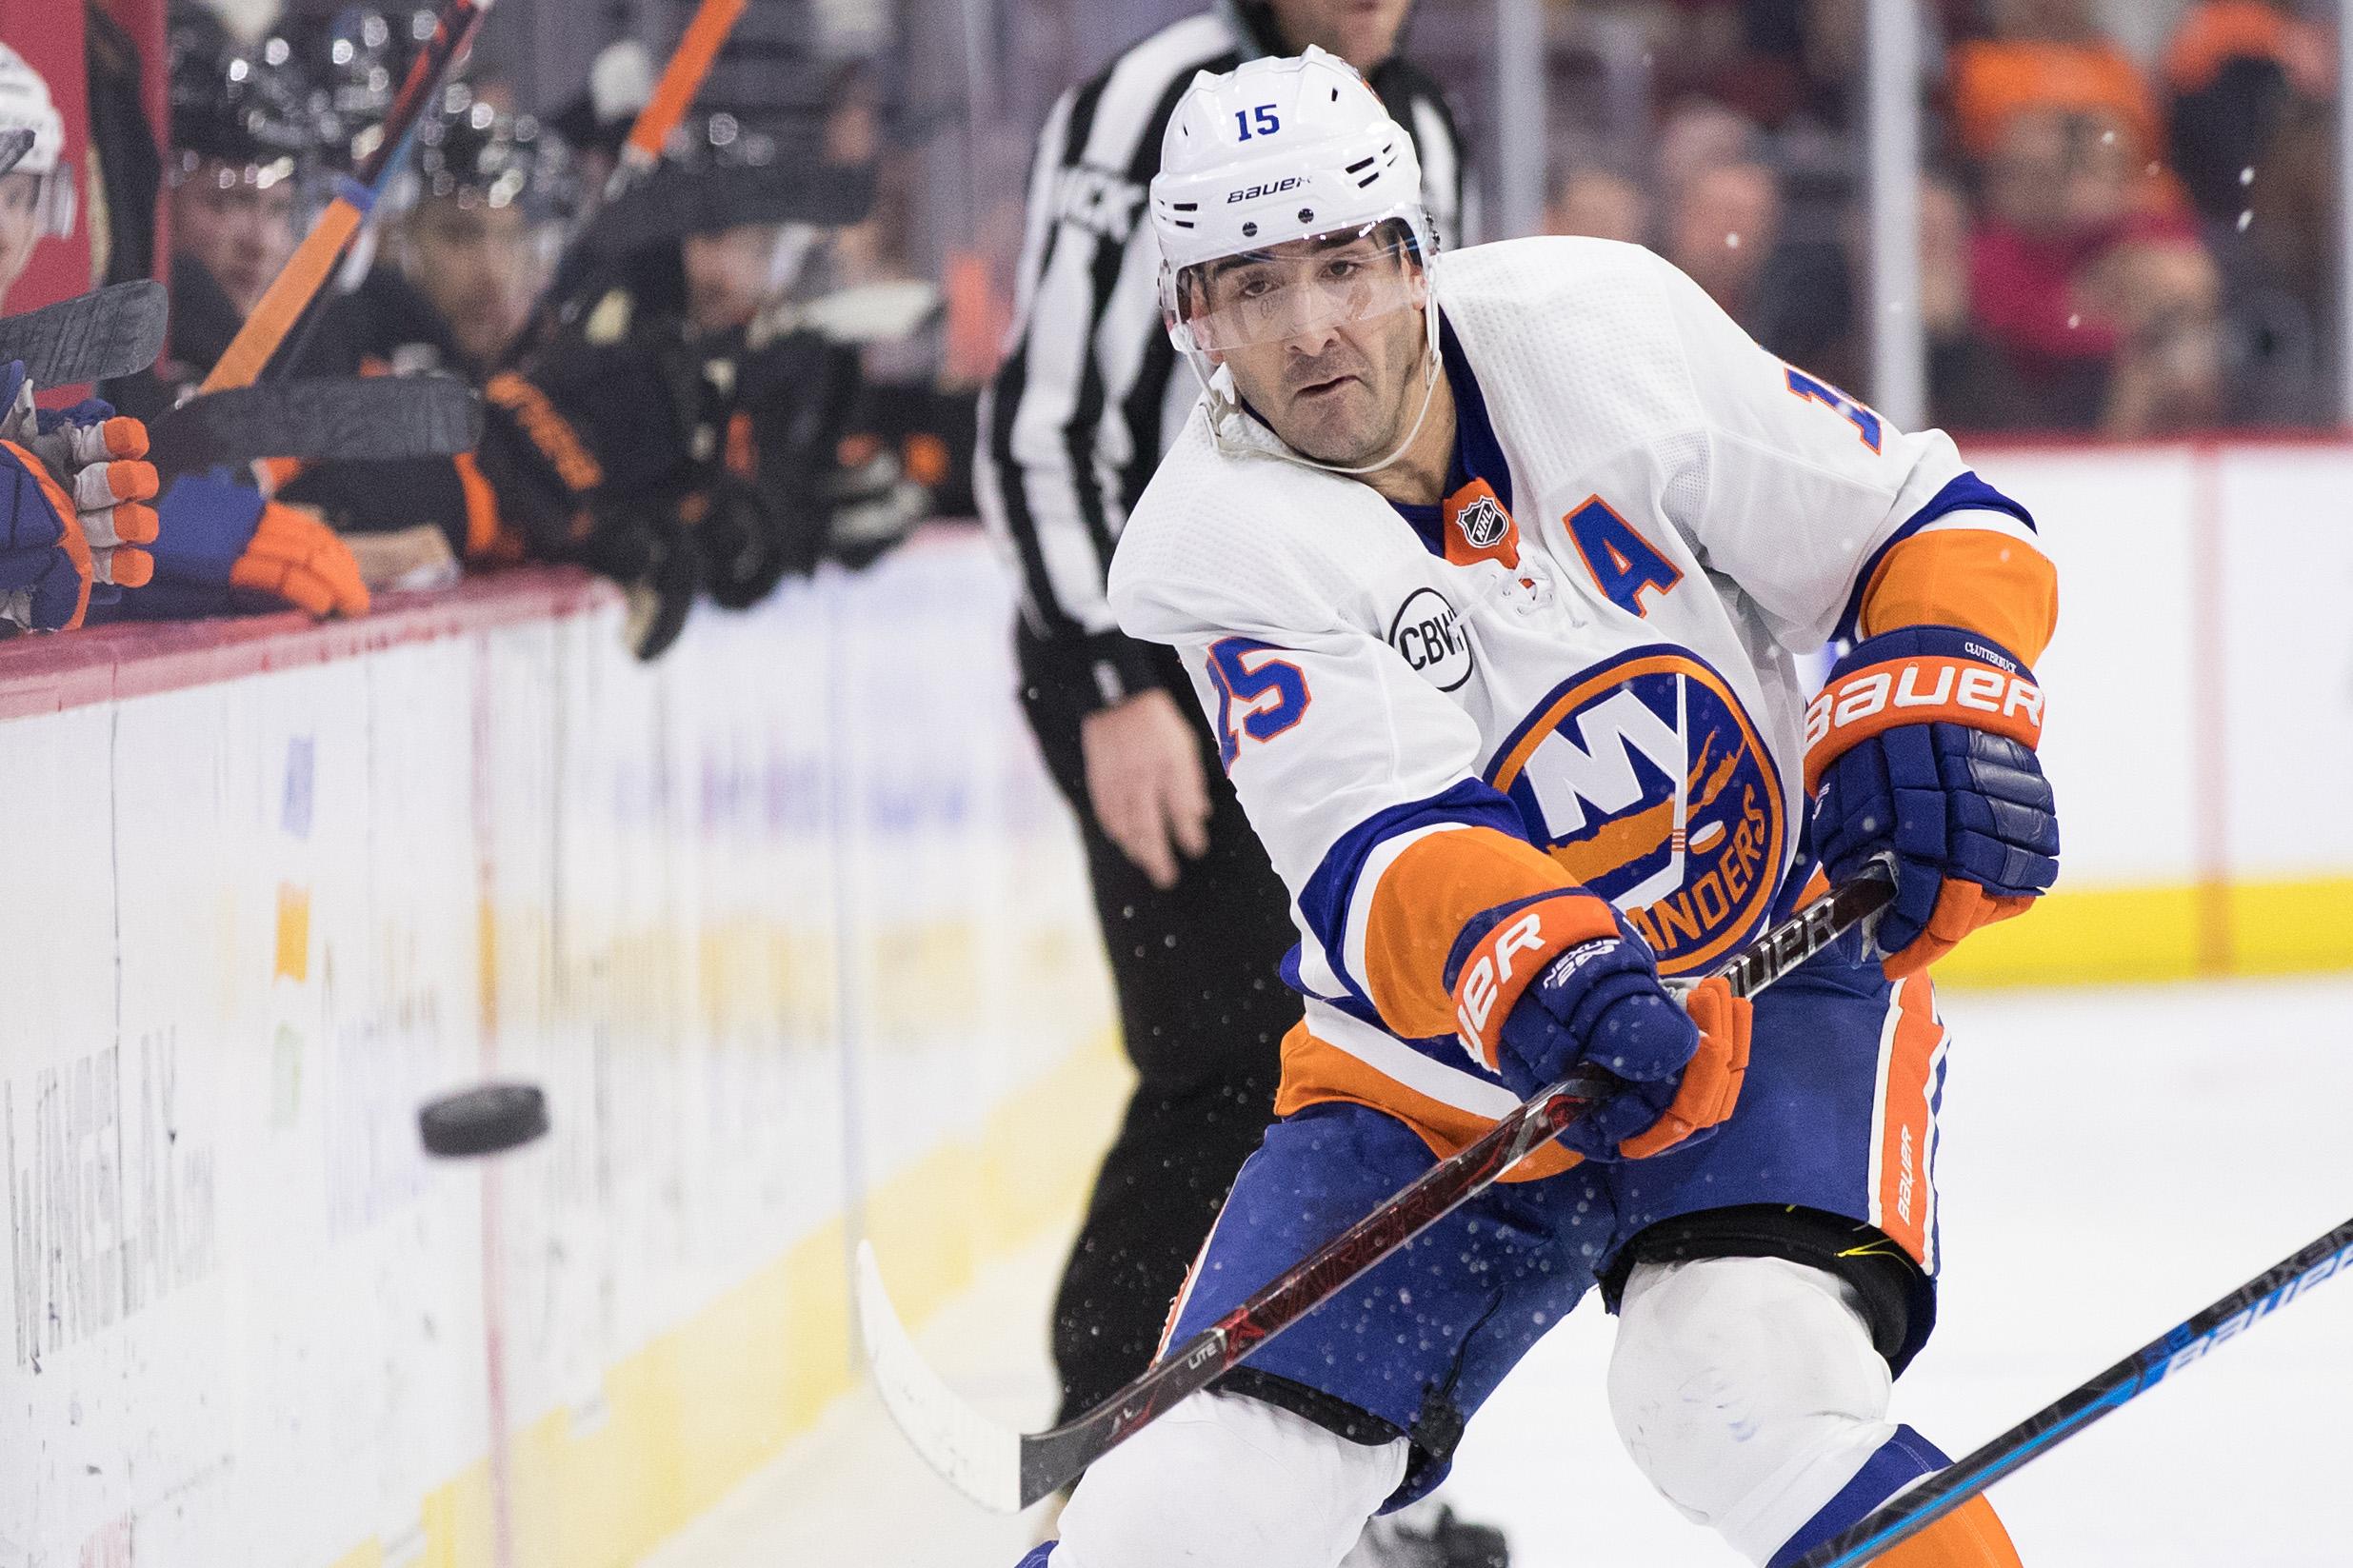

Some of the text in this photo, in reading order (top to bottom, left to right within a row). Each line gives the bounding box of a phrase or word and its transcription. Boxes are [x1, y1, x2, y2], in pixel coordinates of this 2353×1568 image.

[1235, 104, 1280, 142] 15
[1475, 507, 1493, 541] NHL
[1563, 493, 1685, 620] A
[1399, 609, 1466, 671] CBW
[1964, 642, 2017, 674] CLUTTERBUCK
[1525, 673, 1687, 862] NY
[1187, 1342, 1218, 1370] LITE
